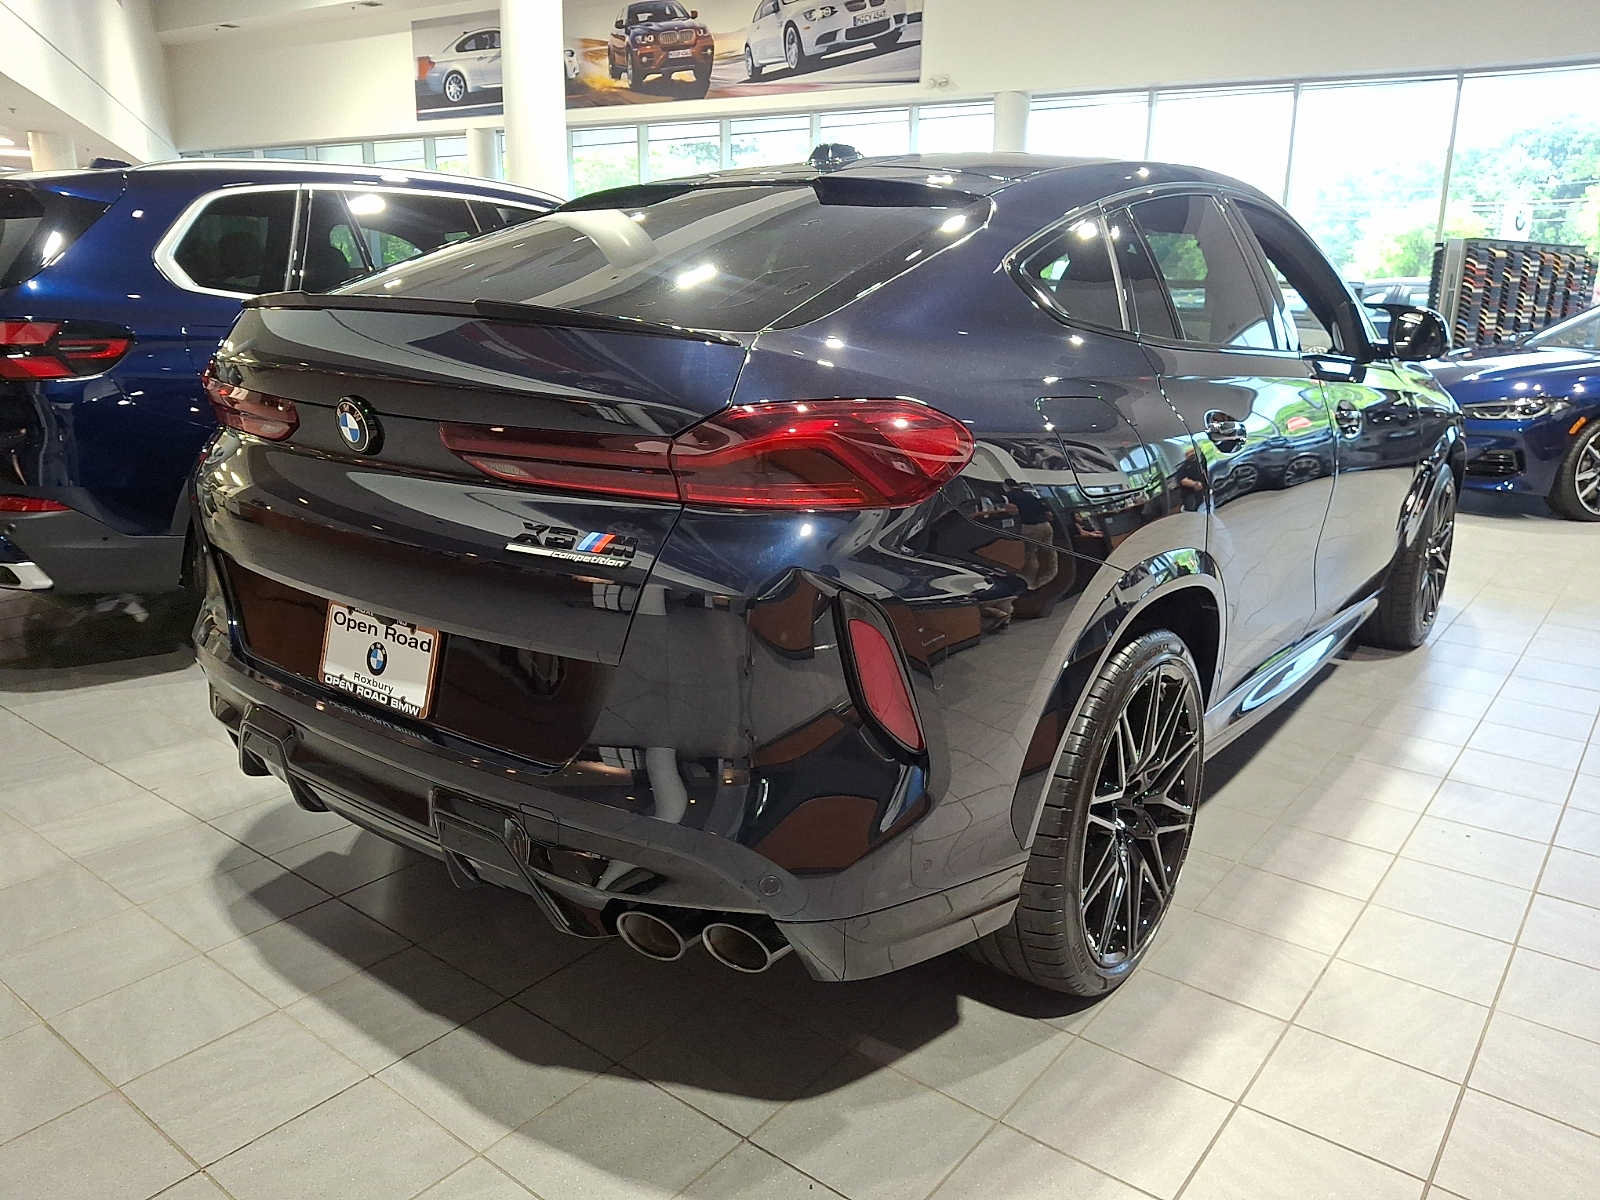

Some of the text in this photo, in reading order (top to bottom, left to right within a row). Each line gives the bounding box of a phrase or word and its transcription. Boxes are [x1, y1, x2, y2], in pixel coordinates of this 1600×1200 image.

[551, 550, 626, 568] competition
[333, 610, 378, 637] Open
[384, 625, 432, 654] Road
[324, 674, 421, 716] OPEN ROAD BMW
[353, 671, 394, 695] Roxbury
